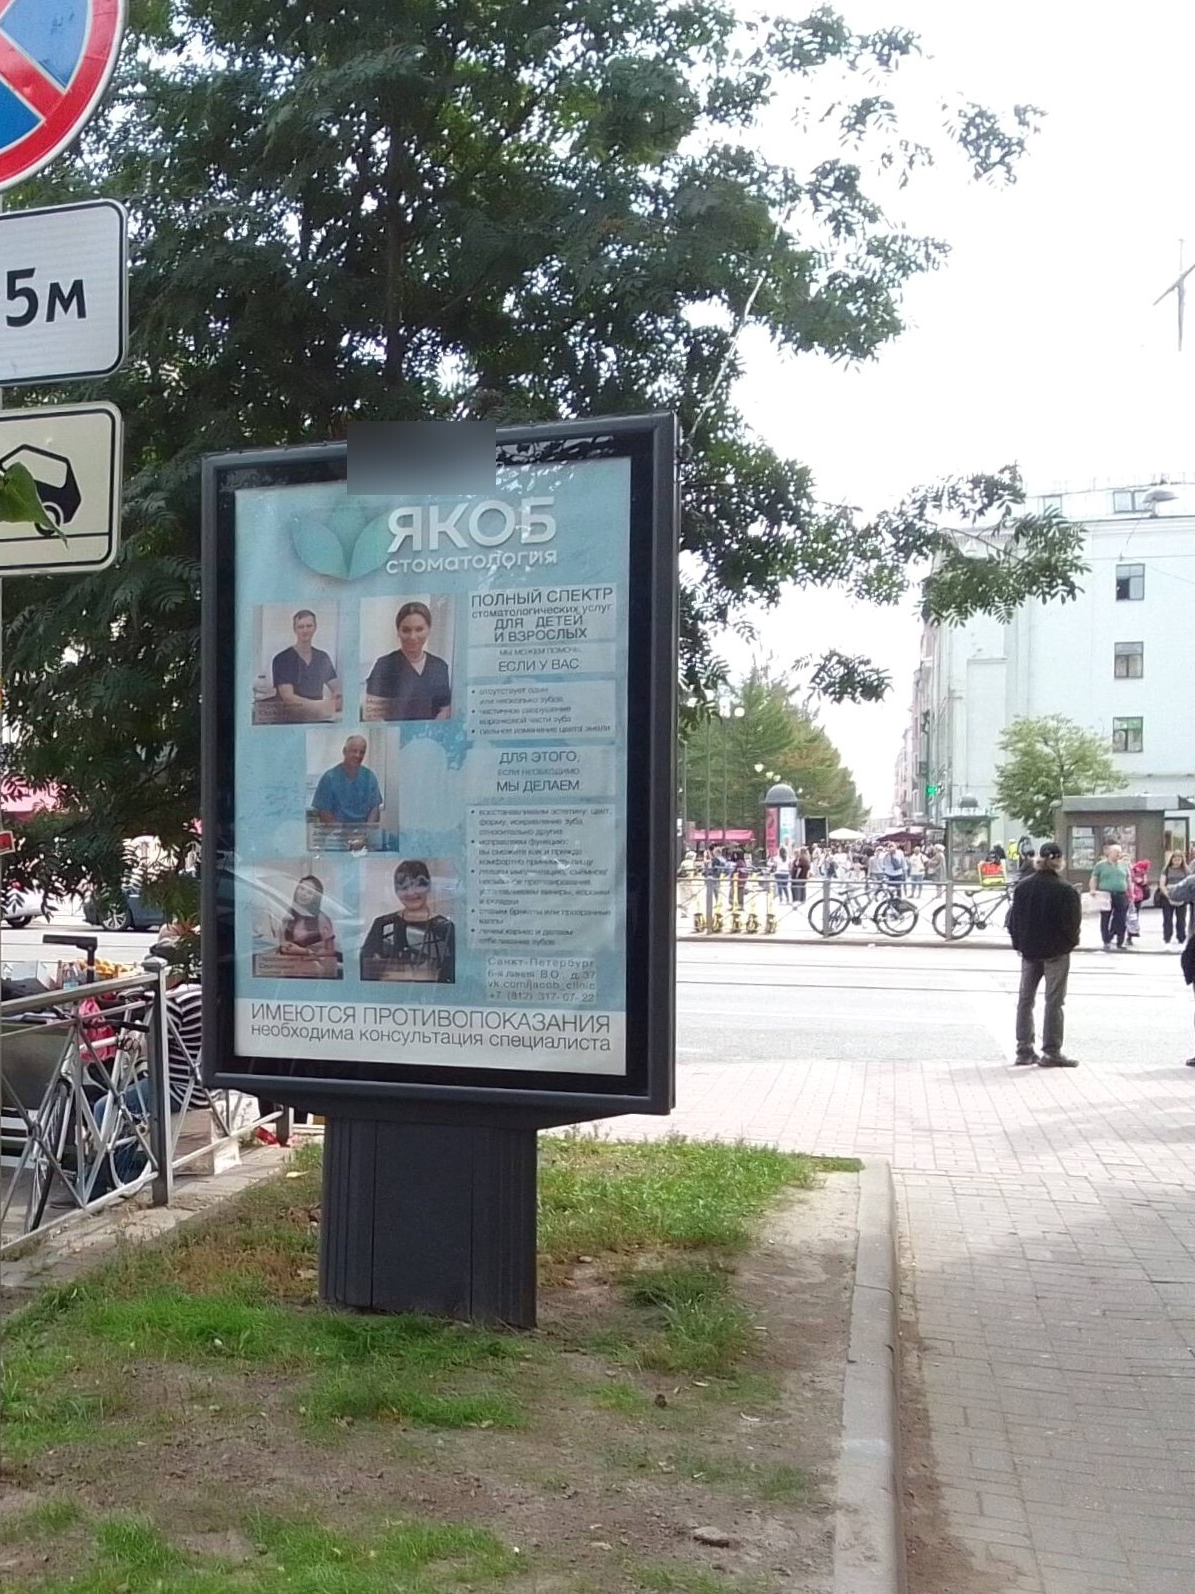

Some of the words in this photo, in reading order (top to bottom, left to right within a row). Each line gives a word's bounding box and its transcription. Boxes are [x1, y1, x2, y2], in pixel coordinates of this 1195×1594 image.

[387, 496, 557, 554] ЯКОБ
[386, 550, 557, 575] стоматология
[471, 589, 542, 608] ПОЛНЫЙ
[546, 587, 613, 603] СПЕКТР
[472, 607, 578, 619] стоматологических
[582, 603, 612, 615] услуг
[494, 618, 524, 631] ДЛЯ
[535, 615, 583, 629] ДЕТЕЙ
[494, 633, 504, 643] И
[508, 628, 587, 642] ВЗРОСЛЫХ
[498, 660, 536, 672] ЕСЛИ
[539, 659, 548, 671] У
[552, 658, 580, 670] ВАС
[499, 752, 527, 764] ДЛЯ
[531, 751, 580, 763] ЭТОГО,
[497, 781, 519, 792] МЫ
[251, 1003, 356, 1024] ИМЕЮТСЯ
[363, 1007, 610, 1034] ПРОТИВОПОКАЗАНИЯ
[251, 1024, 355, 1043] необходима
[359, 1028, 483, 1047] консультация
[489, 1034, 611, 1051] специалиста
